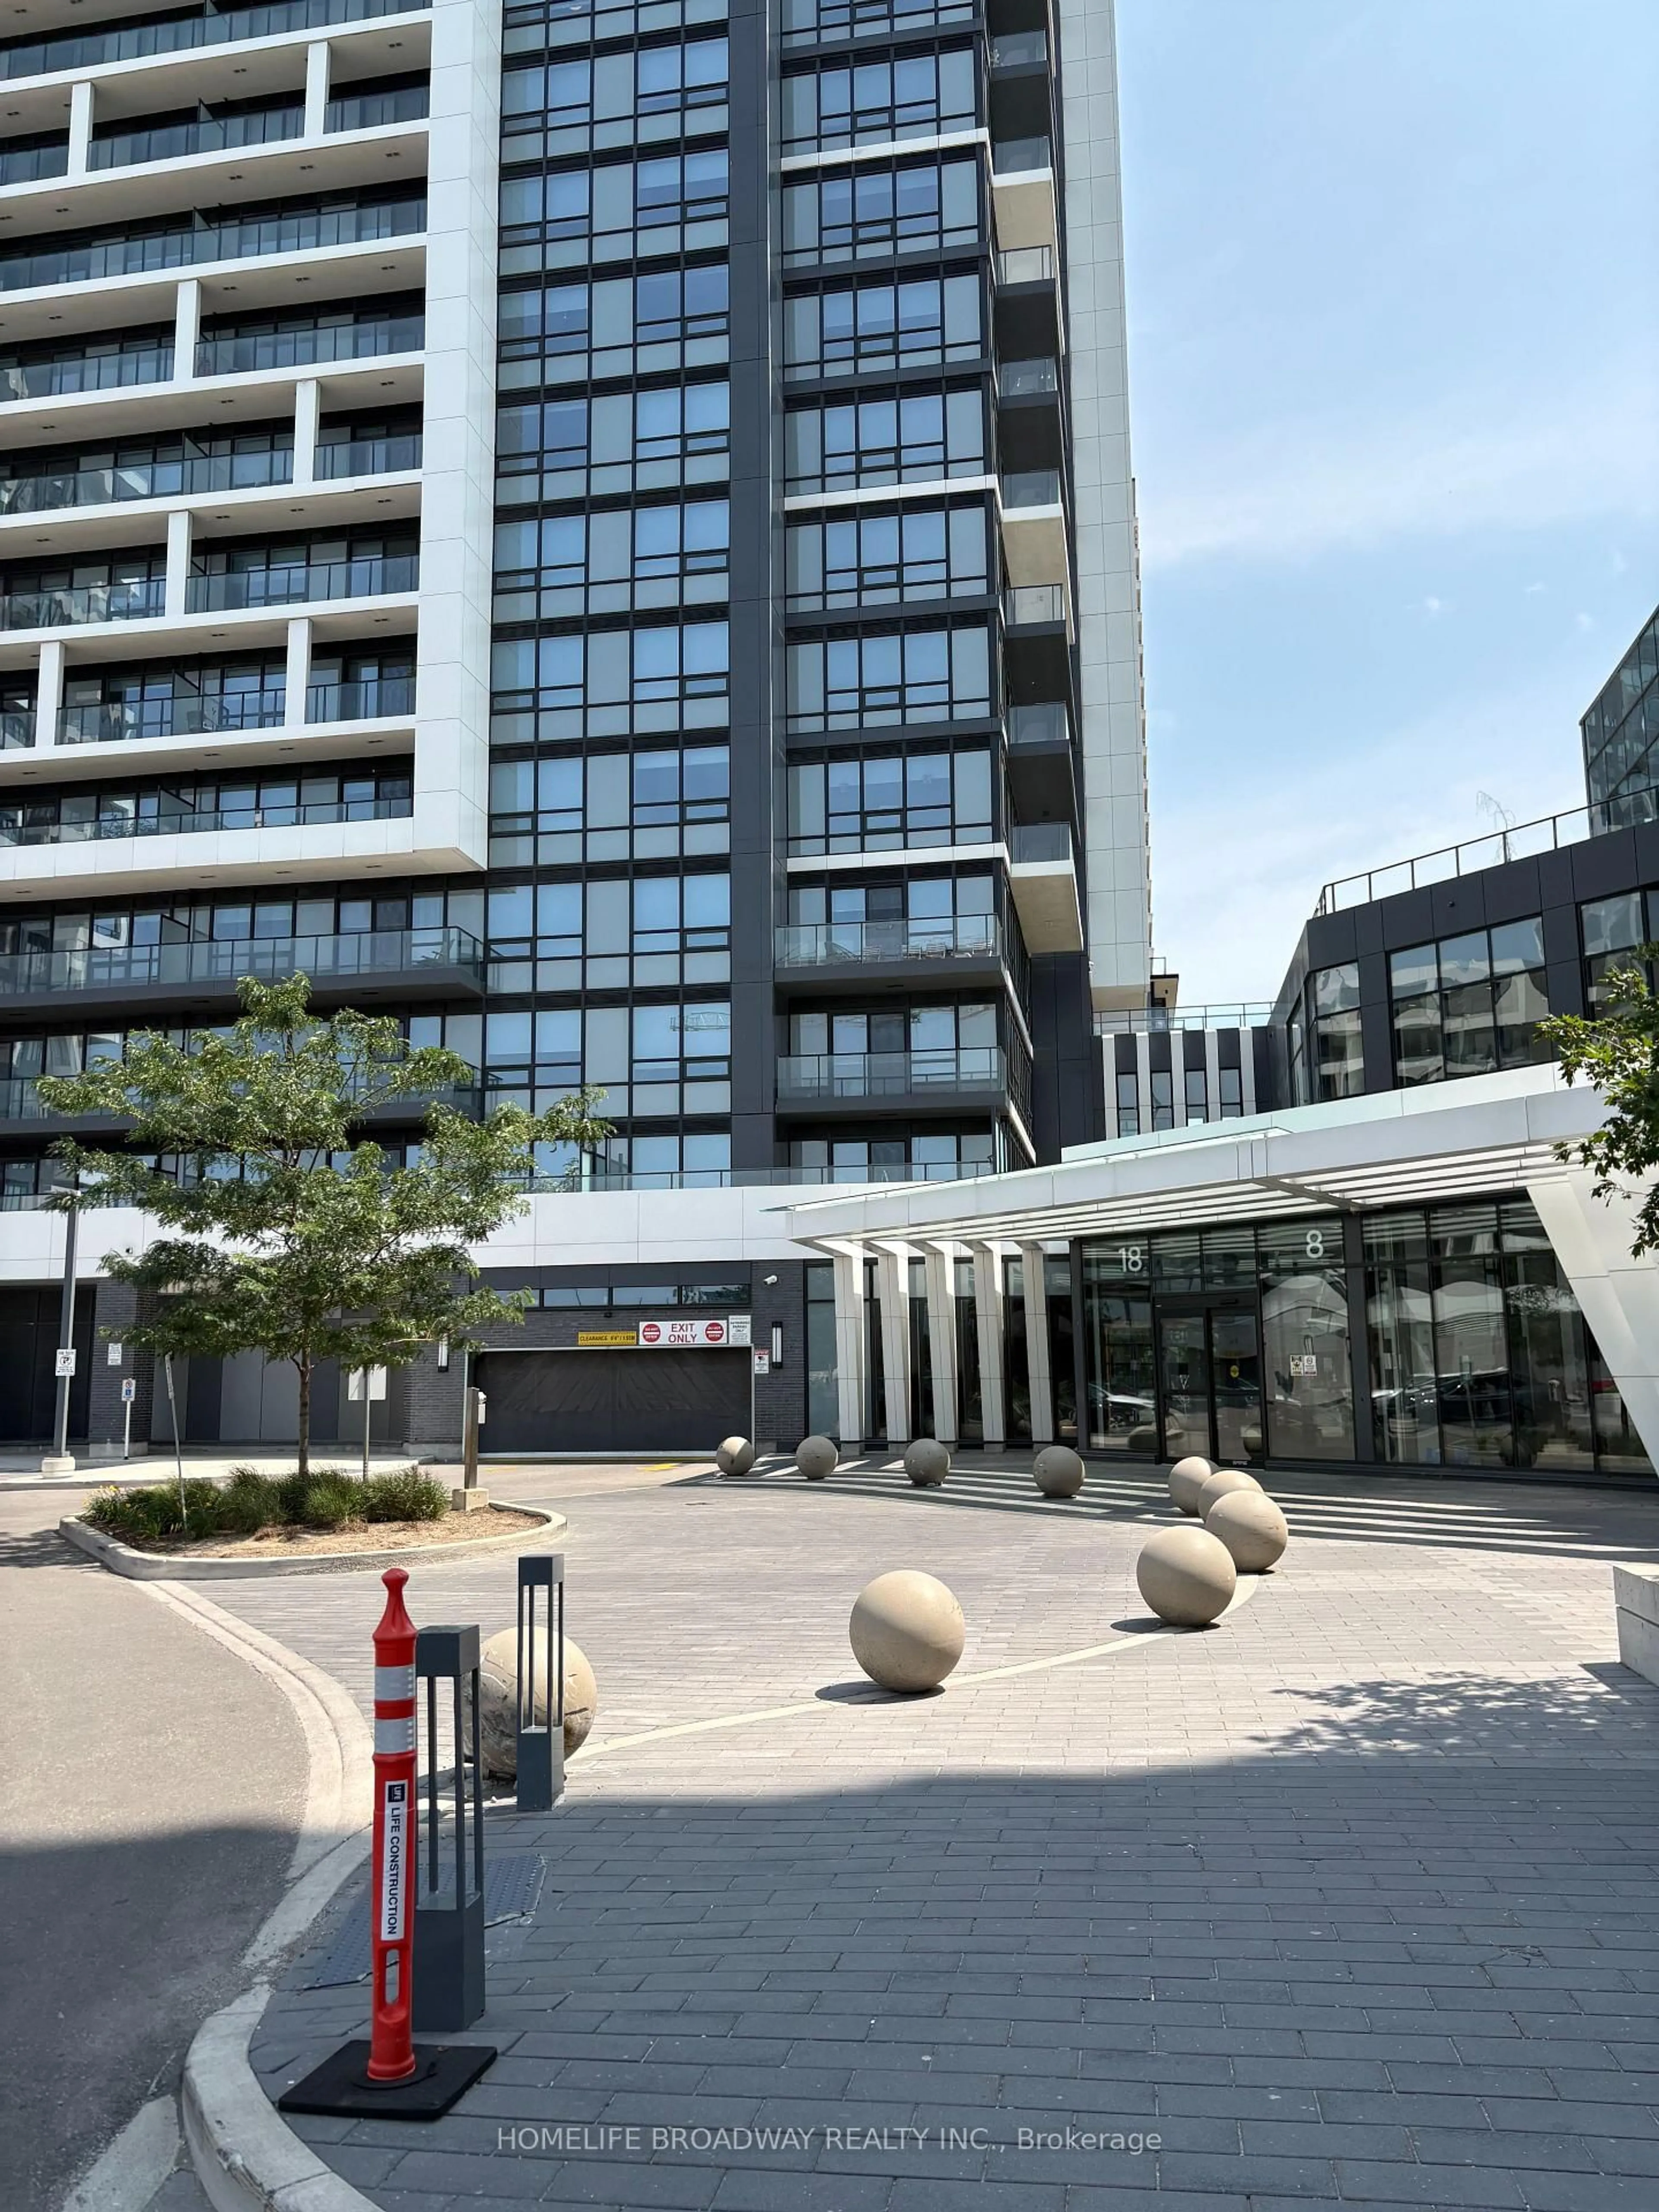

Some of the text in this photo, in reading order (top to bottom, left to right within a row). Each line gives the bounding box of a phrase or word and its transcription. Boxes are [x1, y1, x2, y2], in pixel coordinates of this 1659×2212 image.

[1306, 1230, 1323, 1258] 8
[1118, 1246, 1141, 1272] 18
[671, 1324, 695, 1332] EXIT
[668, 1334, 697, 1343] ONLY
[394, 1786, 402, 1801] LIFE
[387, 1807, 400, 1934] LIFE CONSTRUCTION
